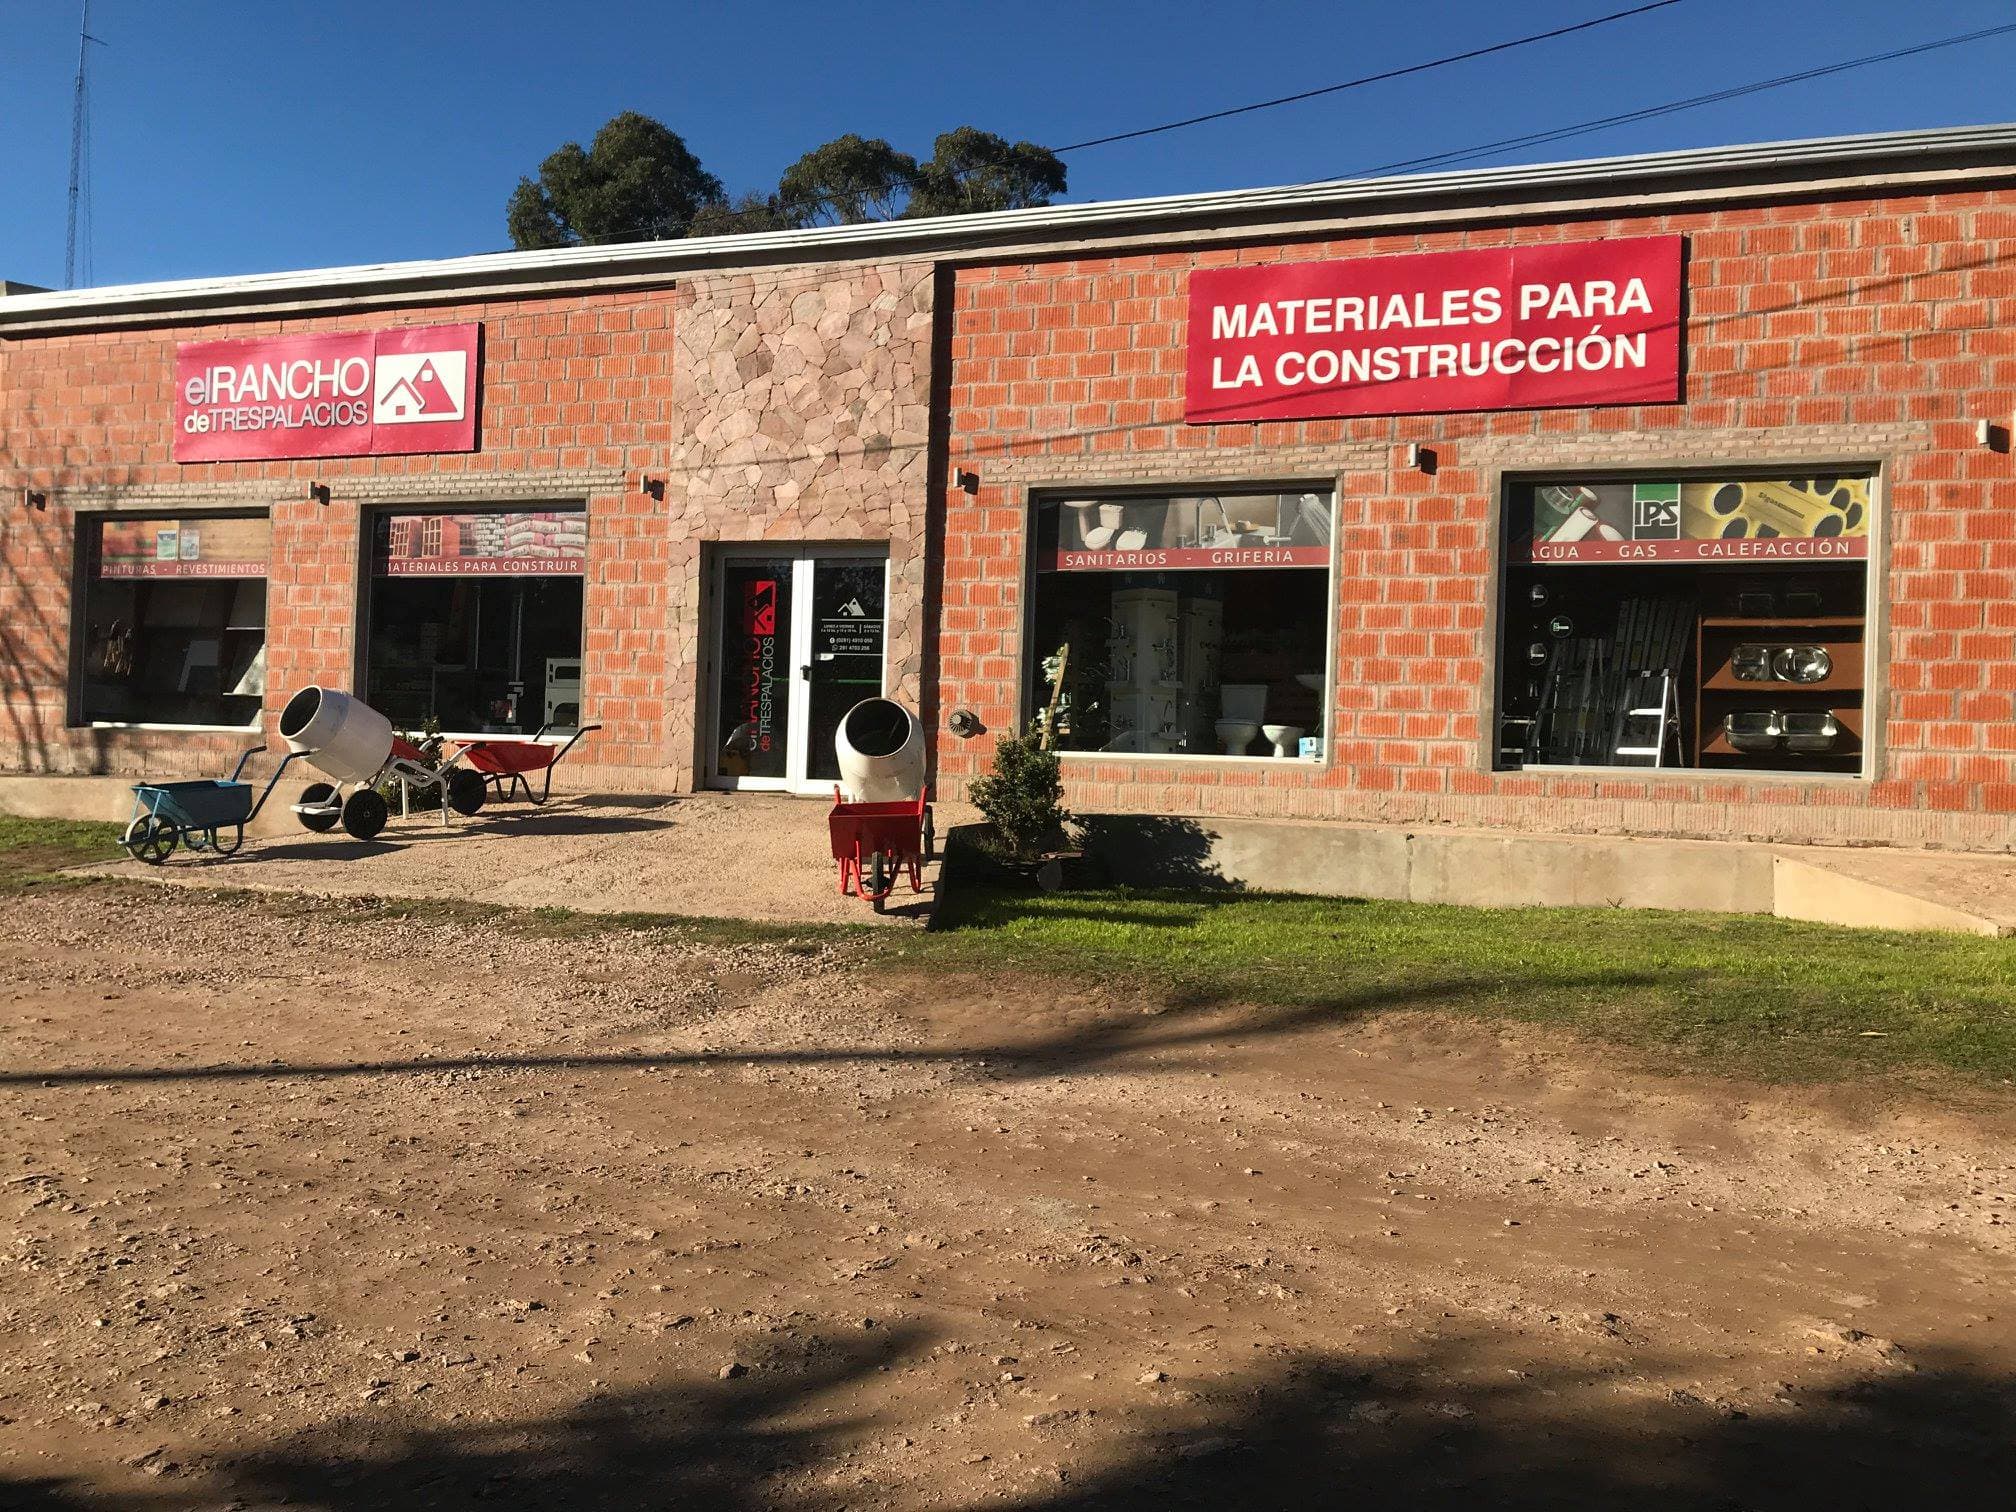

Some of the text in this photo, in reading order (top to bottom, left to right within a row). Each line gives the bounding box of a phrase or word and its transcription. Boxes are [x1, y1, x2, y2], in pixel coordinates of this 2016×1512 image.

[1212, 278, 1654, 340] MATERIALES PARA
[1212, 324, 1647, 389] LA CONSTRUCCIÓN
[1634, 500, 1679, 527] IPS
[1066, 552, 1167, 566] SANITARIOS
[1211, 550, 1294, 564] GRIFERIA
[1618, 544, 1658, 558] GAS
[1698, 538, 1850, 557] CALEFACCIÓN
[102, 563, 156, 576] PINTURAS
[175, 563, 266, 574] REVESTIMIENTOS
[464, 561, 497, 572] PARA
[502, 560, 578, 572] CONSTRUIR
